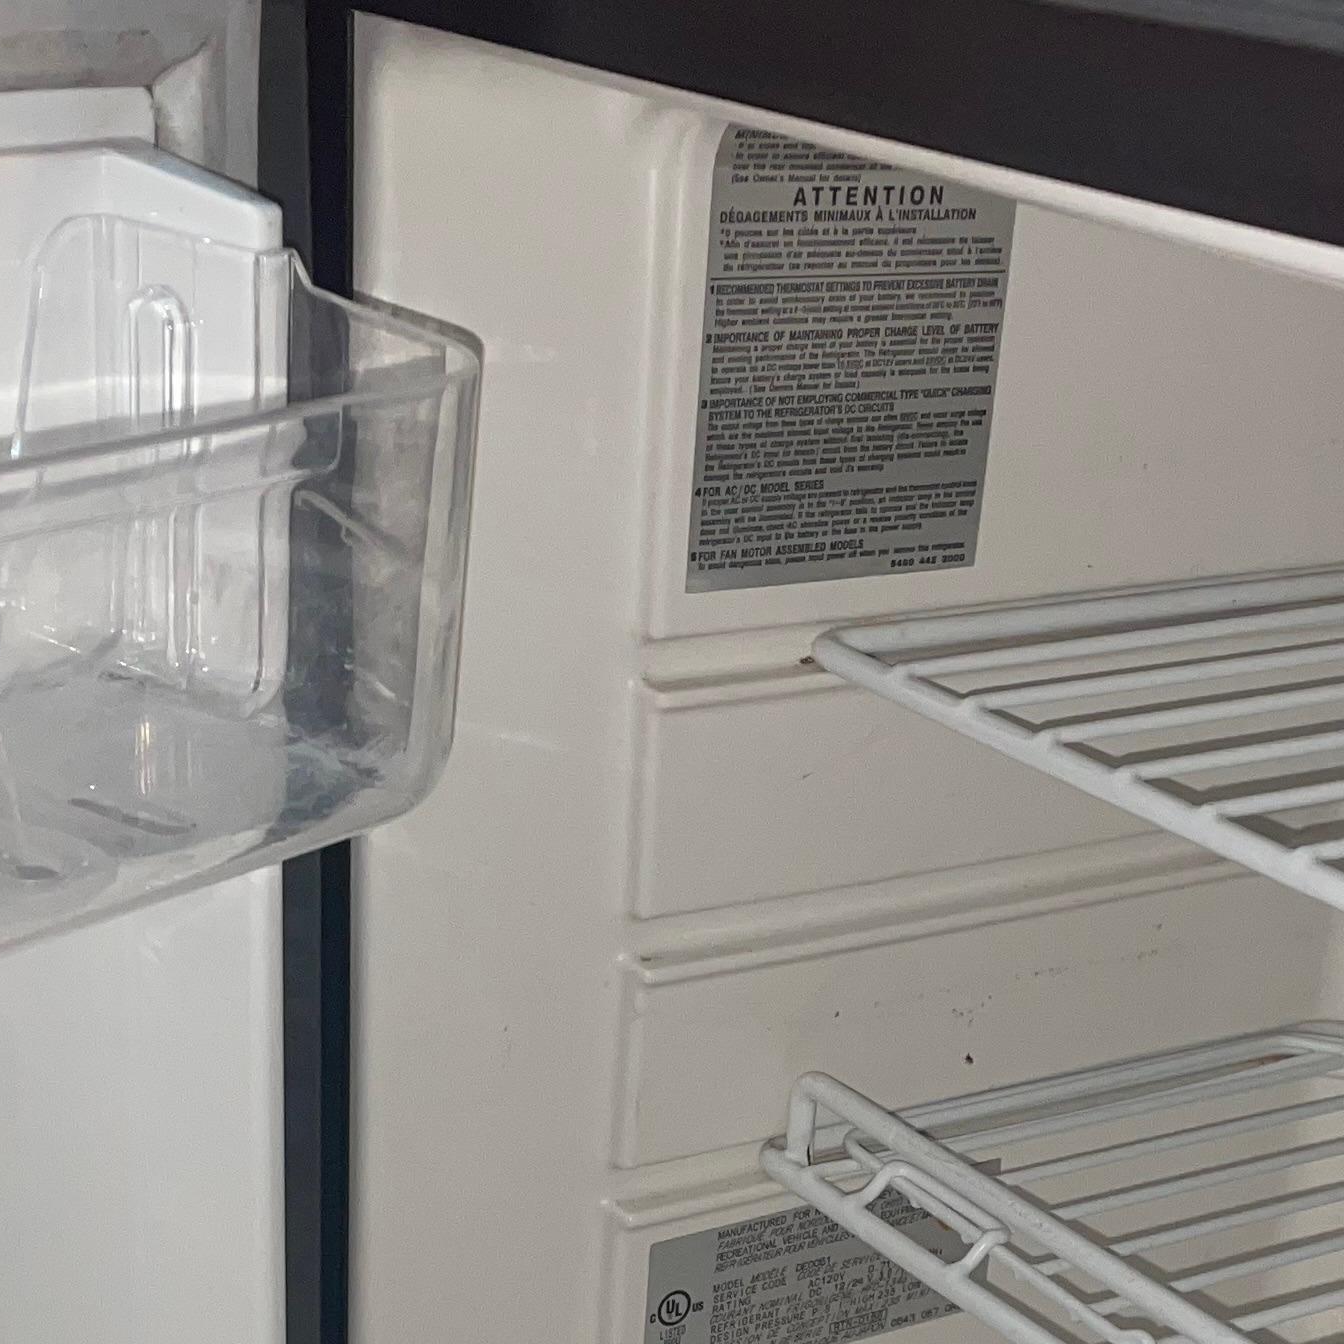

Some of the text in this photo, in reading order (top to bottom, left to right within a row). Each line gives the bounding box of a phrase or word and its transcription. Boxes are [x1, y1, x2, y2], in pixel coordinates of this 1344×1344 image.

[793, 184, 943, 206] ATTENTION
[719, 204, 976, 223] DÉGAGEMENTS MINIMAUX À L'INSTALLATION
[716, 283, 774, 295] RECOMMENDED
[776, 281, 824, 293] THERMOSTAT
[825, 280, 860, 291] SETTINGS
[861, 280, 872, 290] TO
[873, 279, 904, 290] PREVENT
[906, 278, 943, 289] EXCESSIVE
[945, 277, 975, 288] BATTERY
[713, 331, 769, 344] IMPORTANCE
[773, 330, 785, 341] OF
[788, 328, 843, 340] MAINTAINING
[847, 327, 880, 338] PROPER
[884, 326, 917, 337] CHARGE
[921, 324, 944, 335] LEVEL
[949, 324, 960, 333] OF
[964, 322, 999, 334] BATTERY
[709, 396, 763, 409] IMPORTANCE
[764, 395, 776, 406] OF
[778, 394, 794, 405] NOT
[796, 392, 843, 404] EMPLOYING
[844, 390, 897, 403] COMMERCIAL
[899, 388, 919, 399] TYPE
[708, 401, 894, 421] SYSTEM TO THE REFRIGERATOR'S DC CIRCUITS
[694, 487, 701, 497] 4
[702, 486, 721, 497] FOR
[759, 481, 790, 493] MODEL
[794, 479, 824, 491] SERIES
[698, 538, 863, 562] FOR FAN MOTOR ASSEMBLED MODELS
[718, 1215, 786, 1240] MANUFACTURED
[793, 1208, 810, 1220] FOR
[716, 1223, 837, 1262] RECREATIONAL VEHICLE AND
[711, 1296, 750, 1314] RATING
[808, 1271, 845, 1288] AC120V
[713, 1277, 744, 1293] MODEL
[713, 1284, 756, 1304] SERVICE
[762, 1277, 786, 1291] CODE
[665, 1297, 703, 1319] UL US
[710, 1305, 754, 1324] COURANT
[759, 1292, 802, 1311] NOMINAL
[809, 1287, 821, 1297] DC
[660, 1324, 686, 1339] LISTED
[710, 1327, 748, 1344] DESIGN
[755, 1311, 804, 1331] PRESSURE
[711, 1308, 779, 1334] REFRIGERANT
